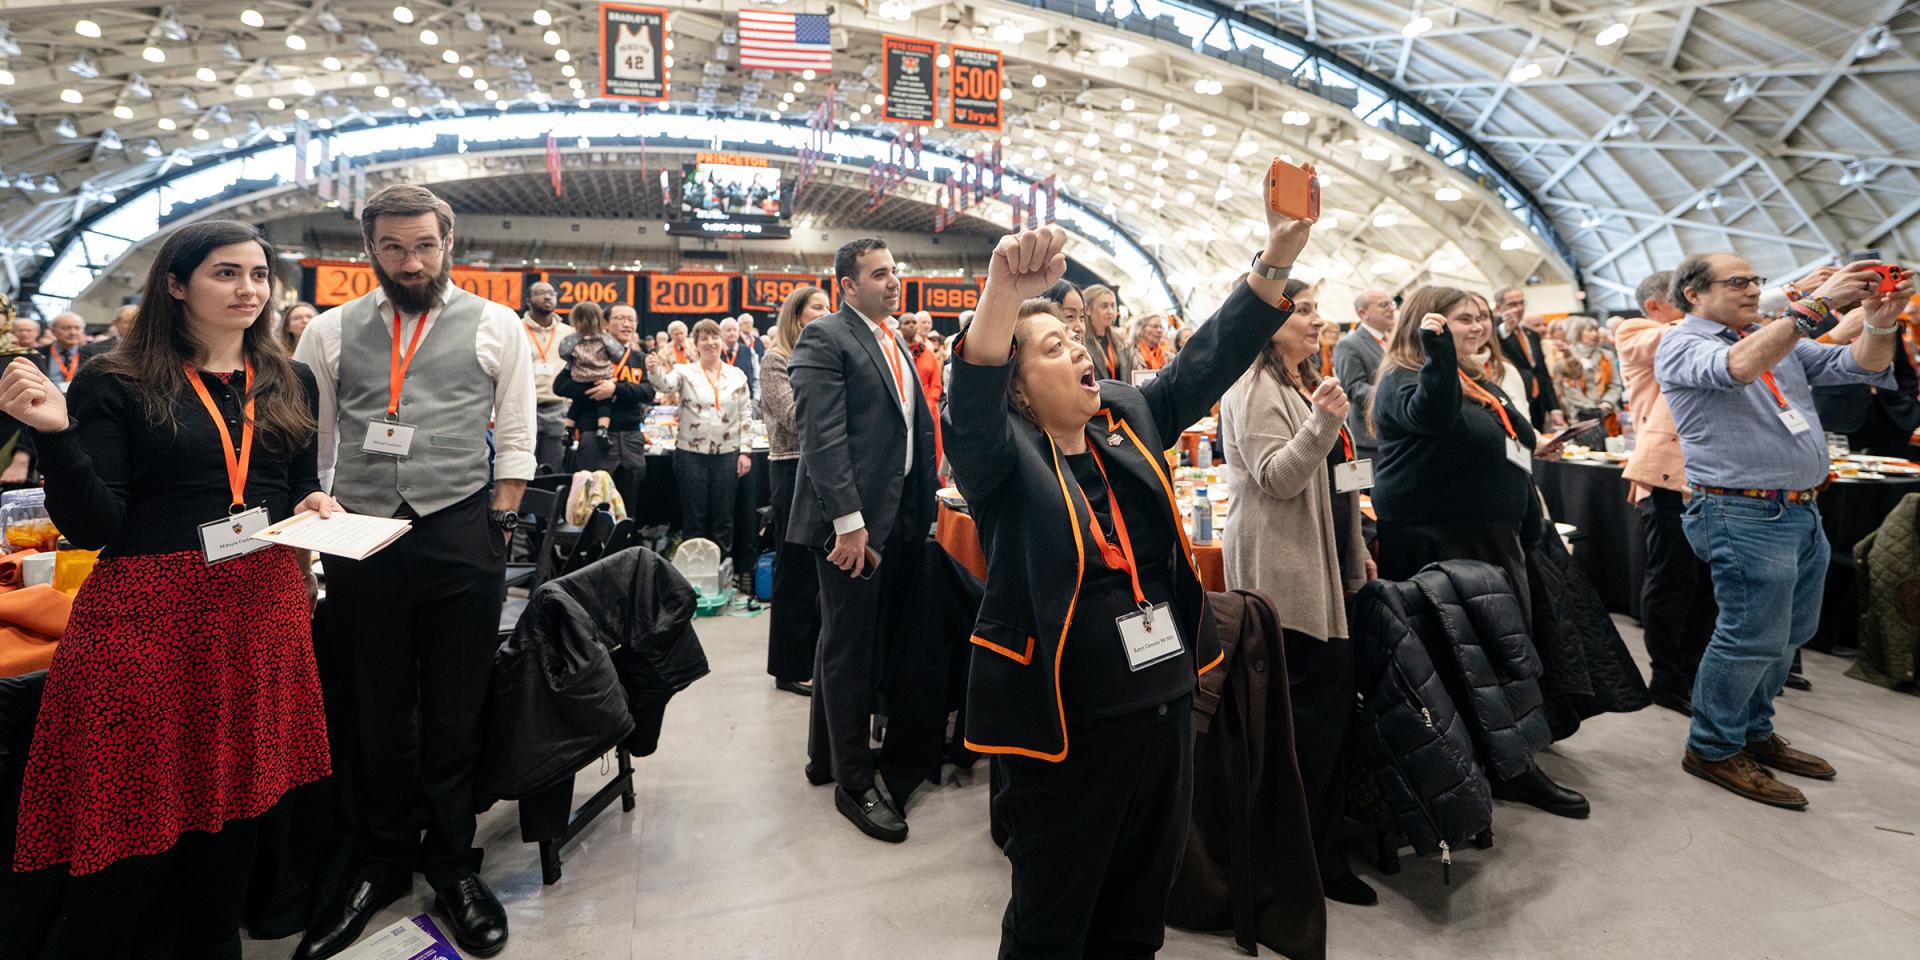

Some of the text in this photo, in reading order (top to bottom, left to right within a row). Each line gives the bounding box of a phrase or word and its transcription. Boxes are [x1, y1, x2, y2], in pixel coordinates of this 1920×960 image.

[625, 56, 644, 70] 42
[954, 49, 998, 61] PRINCETON
[955, 65, 997, 101] 500
[696, 152, 768, 167] PRINCETON
[558, 281, 618, 303] 2006
[655, 281, 724, 306] 2001
[926, 287, 978, 309] 1986
